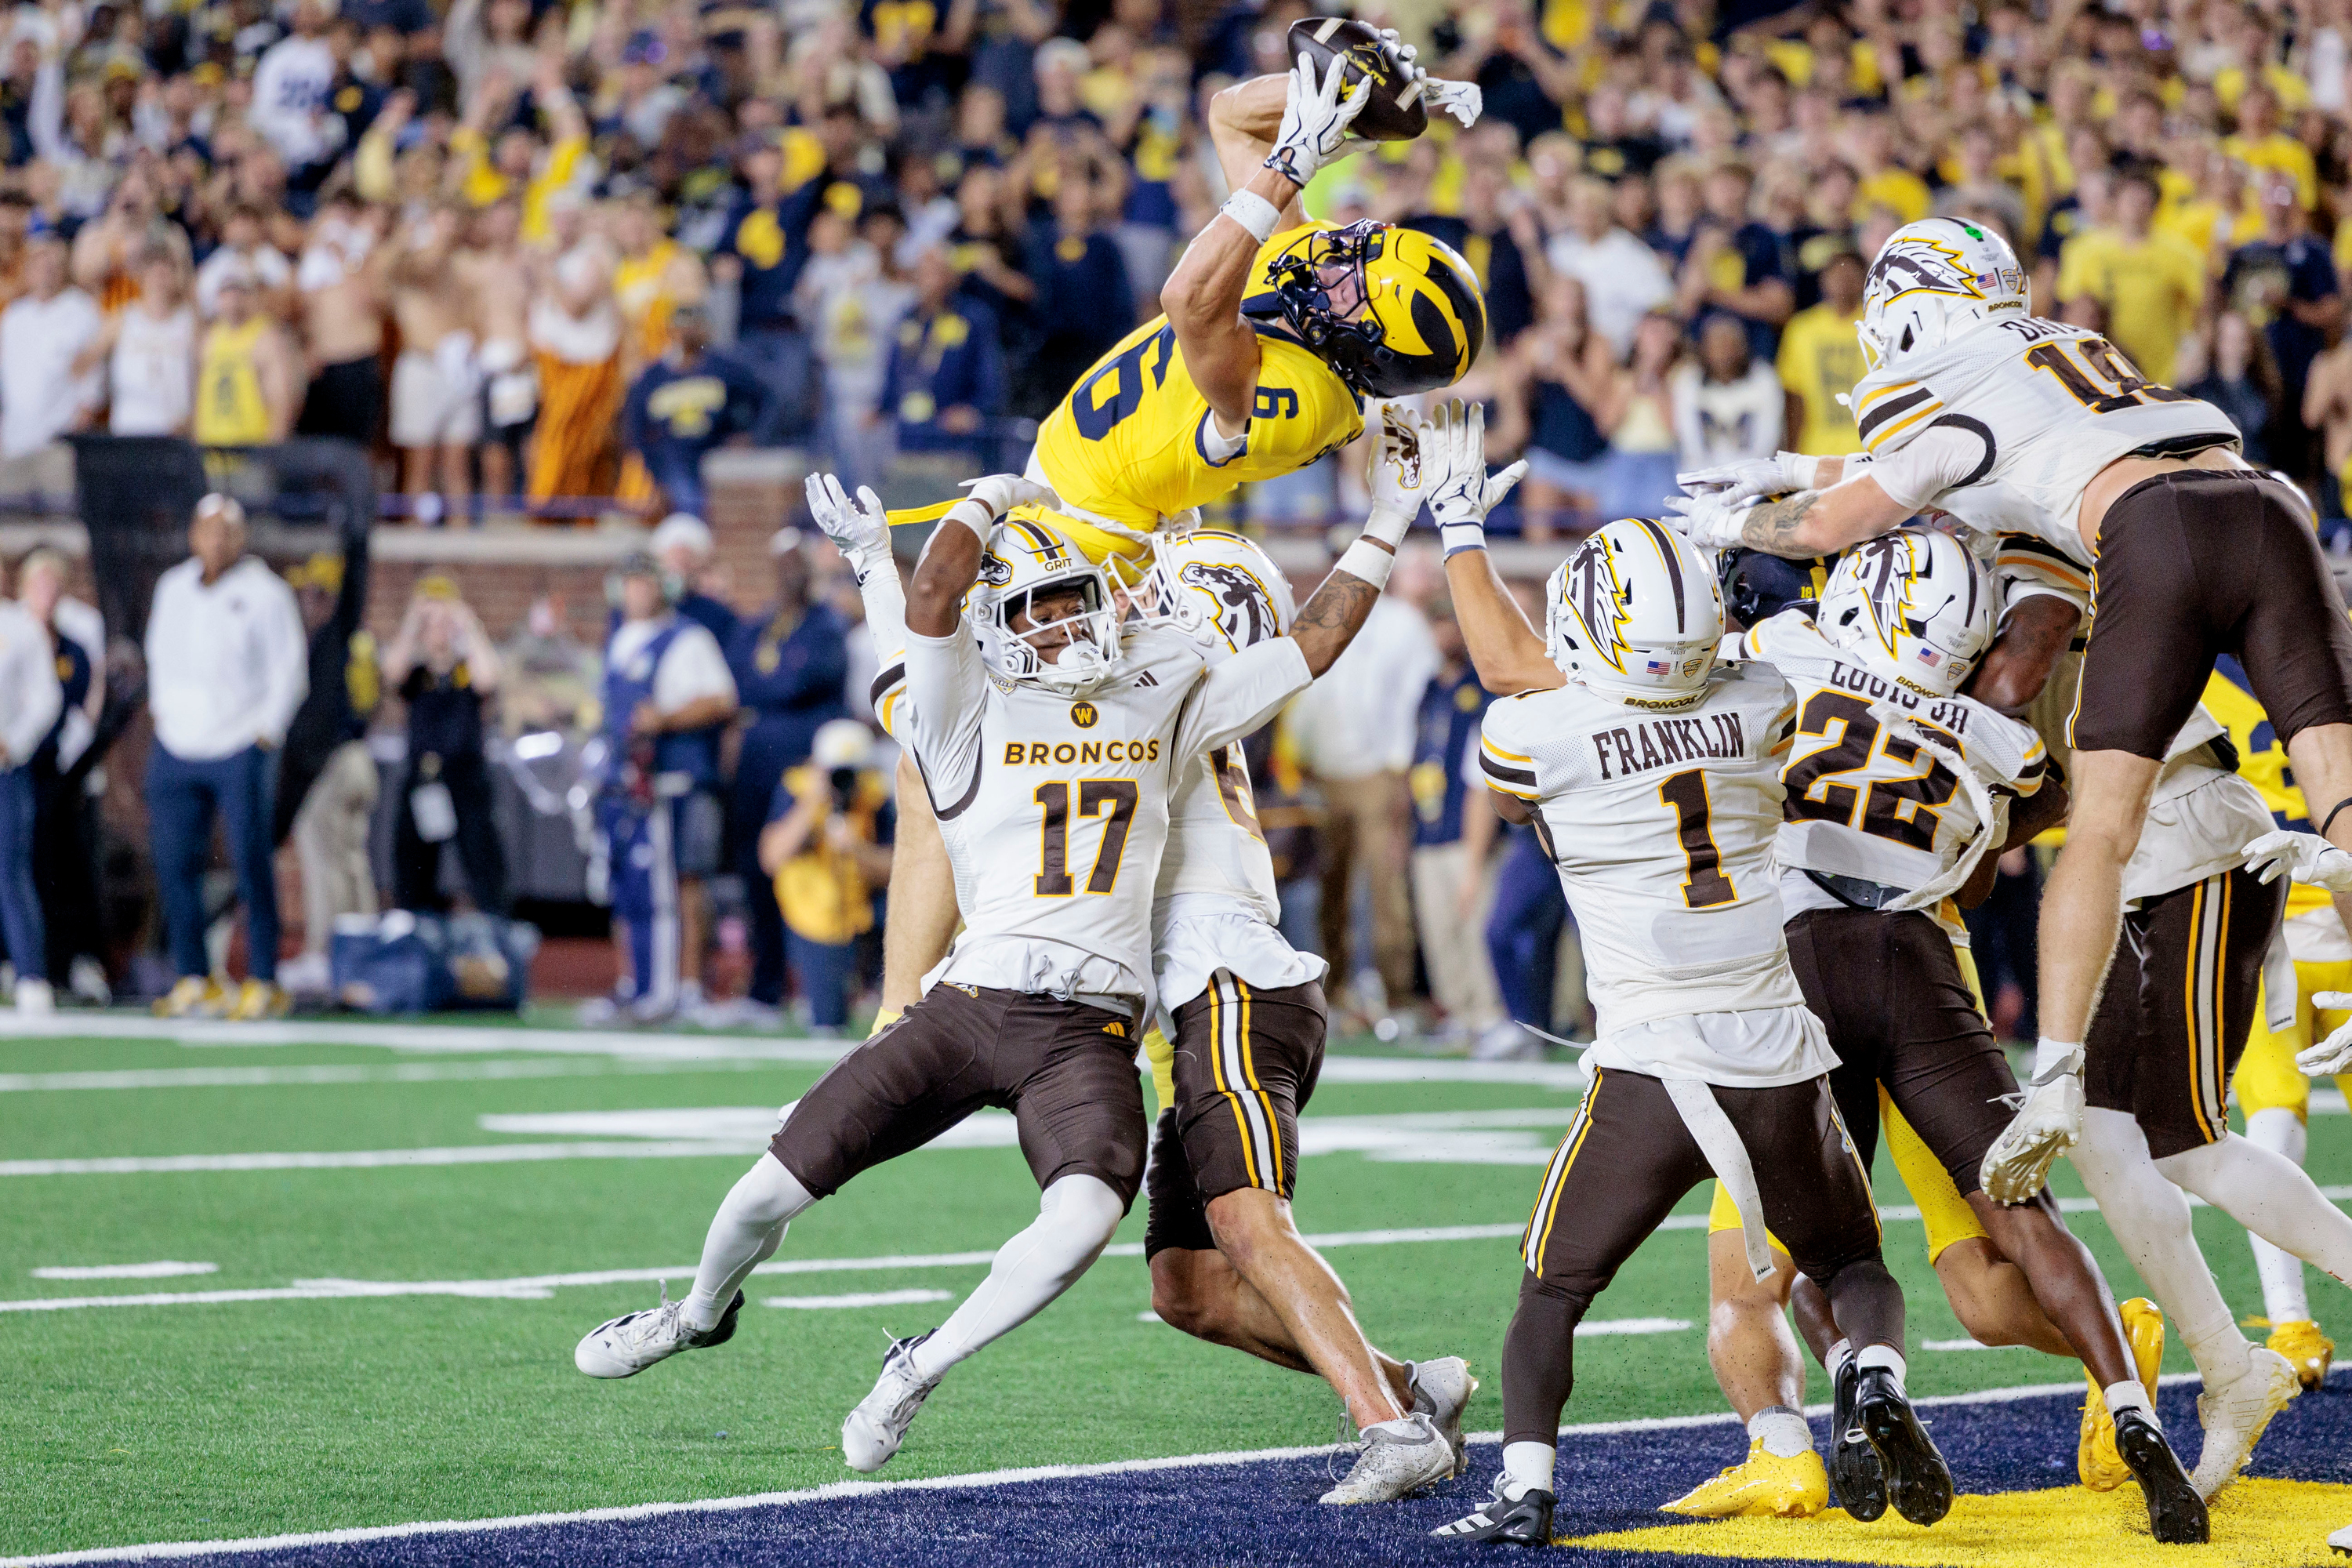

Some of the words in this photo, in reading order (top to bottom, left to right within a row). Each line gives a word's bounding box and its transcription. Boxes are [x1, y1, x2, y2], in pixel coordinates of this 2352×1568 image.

[1987, 301, 2023, 312] BRONCOS
[1252, 386, 1299, 419] 6
[1044, 557, 1073, 572] GRIT
[1800, 586, 1813, 599] 18
[1074, 707, 1094, 724] W
[1623, 694, 1698, 710] BRONCOS
[1002, 738, 1160, 766] BRONCOS
[1592, 712, 1744, 780] FRANKLIN
[1780, 687, 1966, 853] 22
[1033, 778, 1141, 898] 17
[1658, 768, 1740, 908] 1
